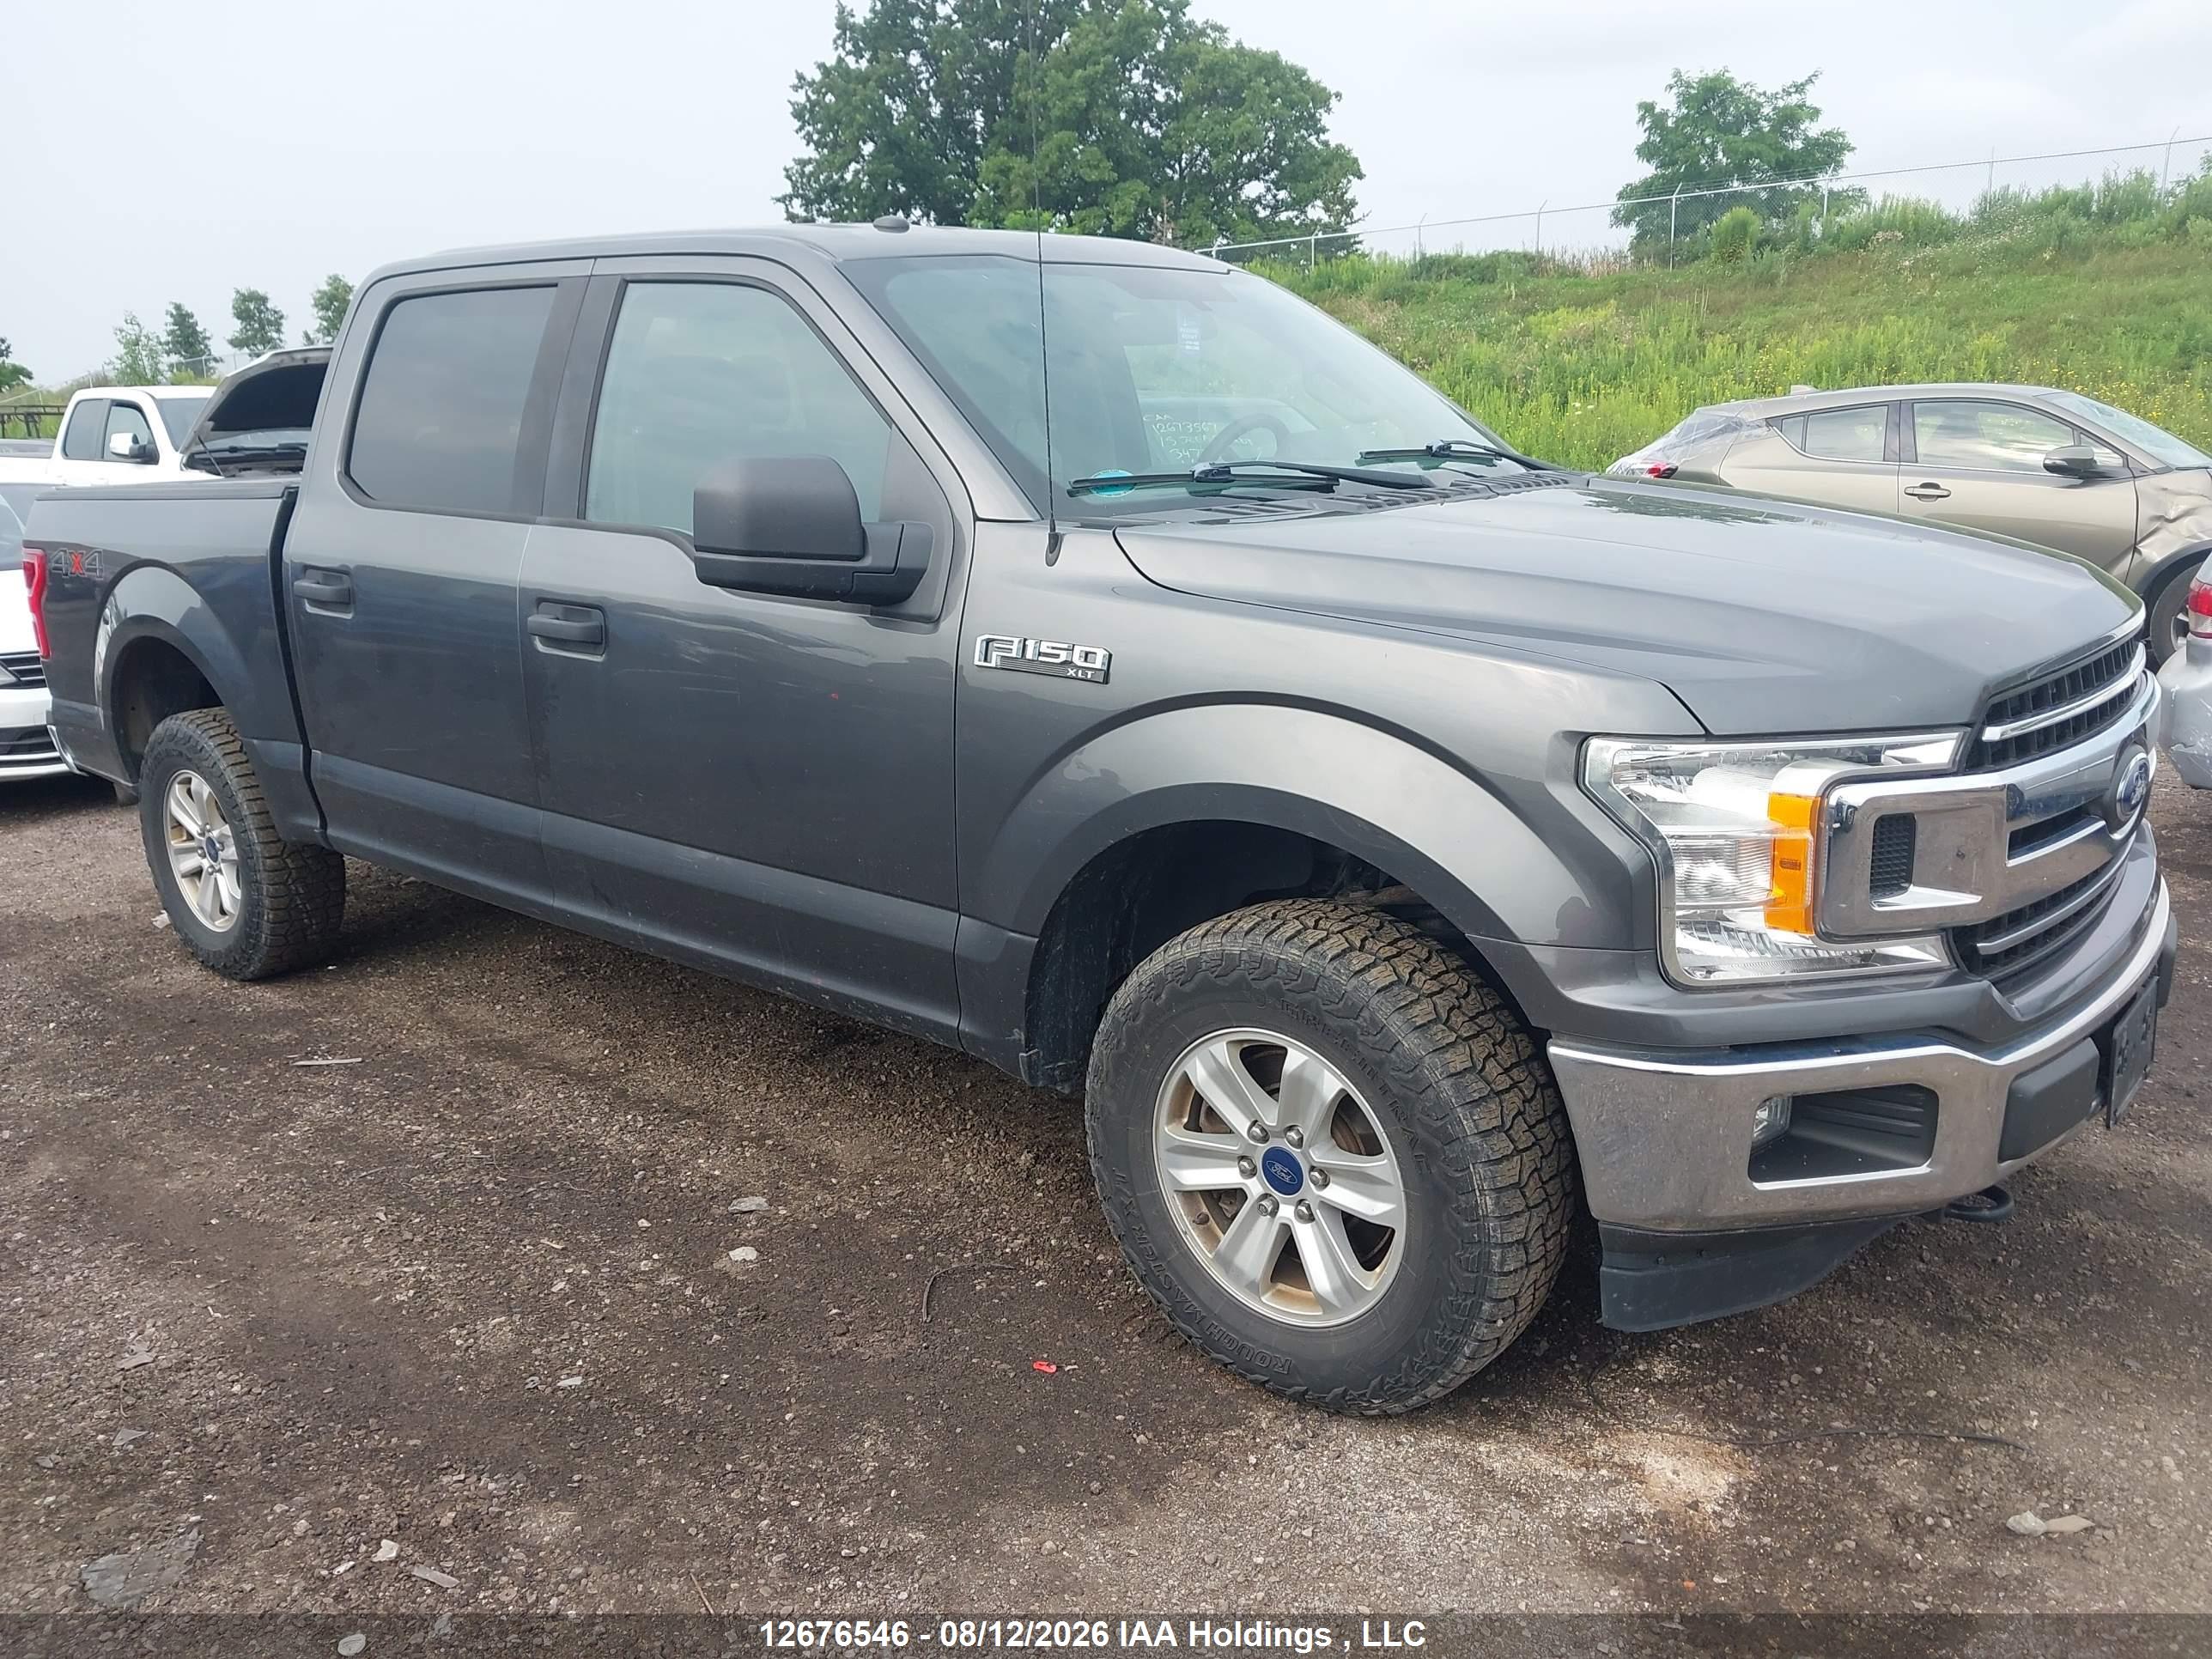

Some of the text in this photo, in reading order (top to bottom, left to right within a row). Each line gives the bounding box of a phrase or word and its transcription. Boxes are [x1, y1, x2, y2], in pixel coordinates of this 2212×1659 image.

[973, 634, 1110, 671] F150
[1066, 667, 1096, 679] XLT
[1130, 1224, 1206, 1324] MASTER
[1205, 1321, 1293, 1375] ROUGH
